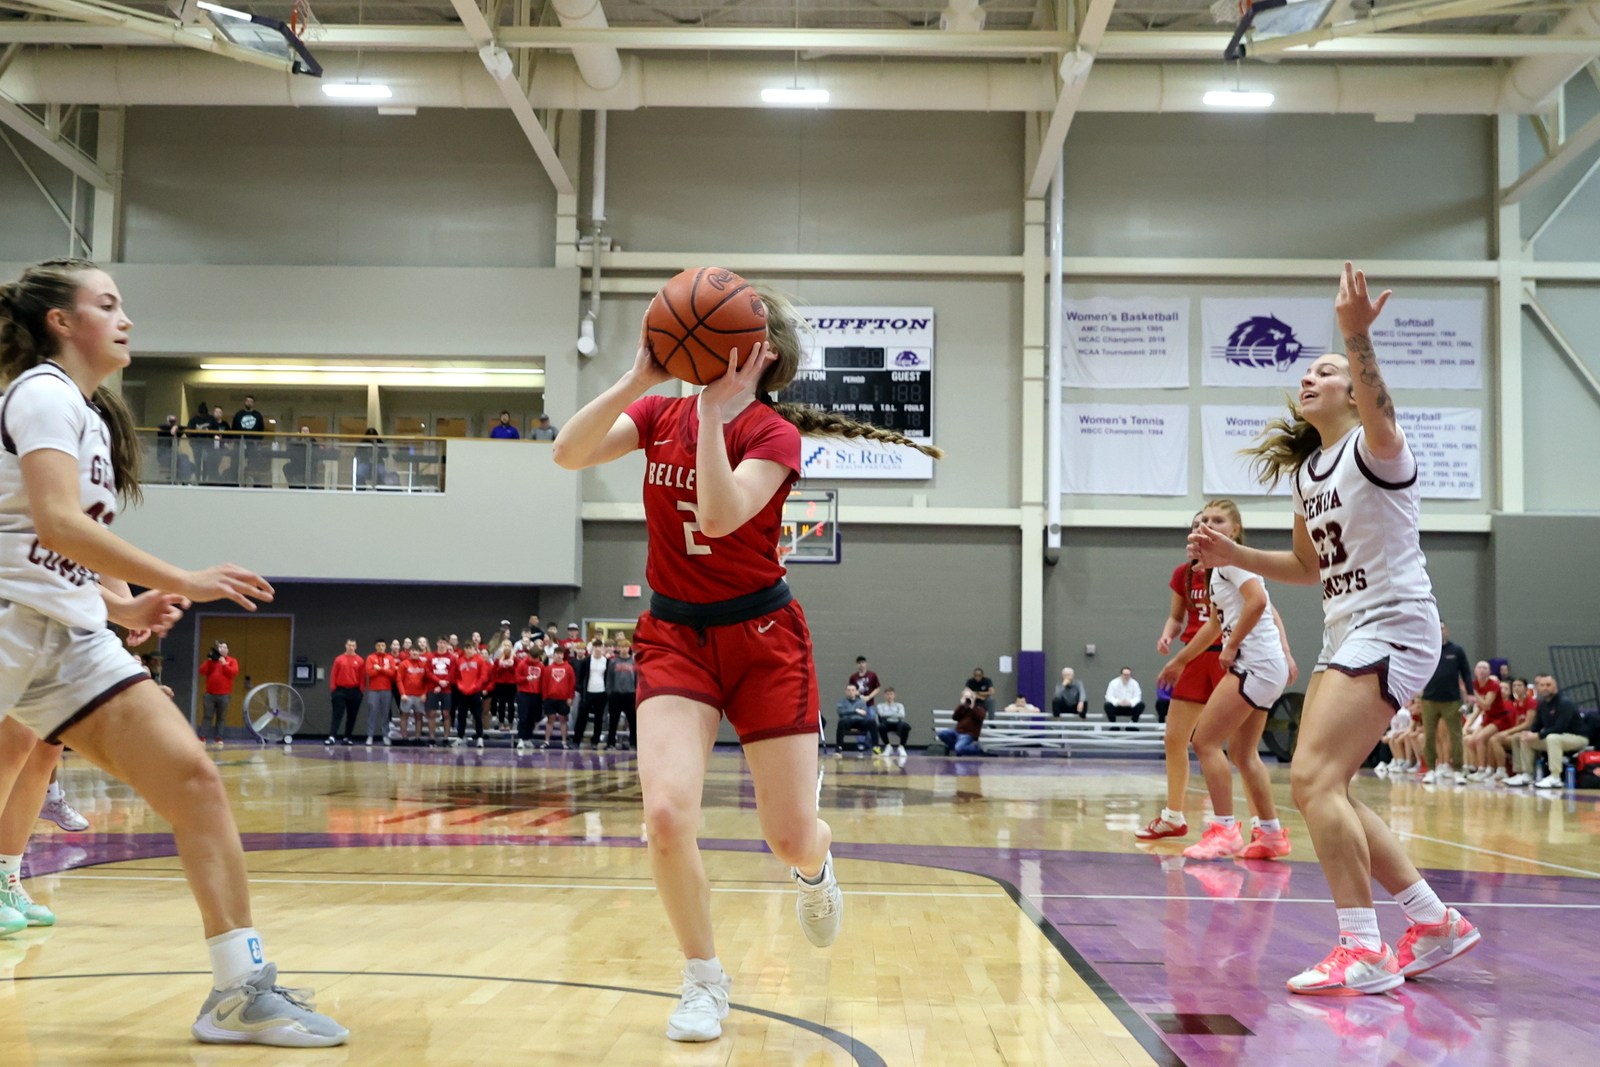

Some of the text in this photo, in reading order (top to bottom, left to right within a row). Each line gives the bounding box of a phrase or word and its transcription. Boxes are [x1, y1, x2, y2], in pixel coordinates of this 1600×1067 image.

[1066, 312, 1179, 322] Women's Basketball
[1394, 318, 1434, 327] Softball
[843, 376, 865, 384] PERIOD
[892, 372, 921, 382] GUEST
[904, 404, 924, 412] FOULS
[1080, 416, 1164, 426] Women's Tennis
[1226, 417, 1270, 426] Women
[1396, 412, 1441, 422] olleyball
[648, 462, 696, 491] BELLE
[676, 500, 713, 555] 2
[1323, 568, 1368, 600] METS
